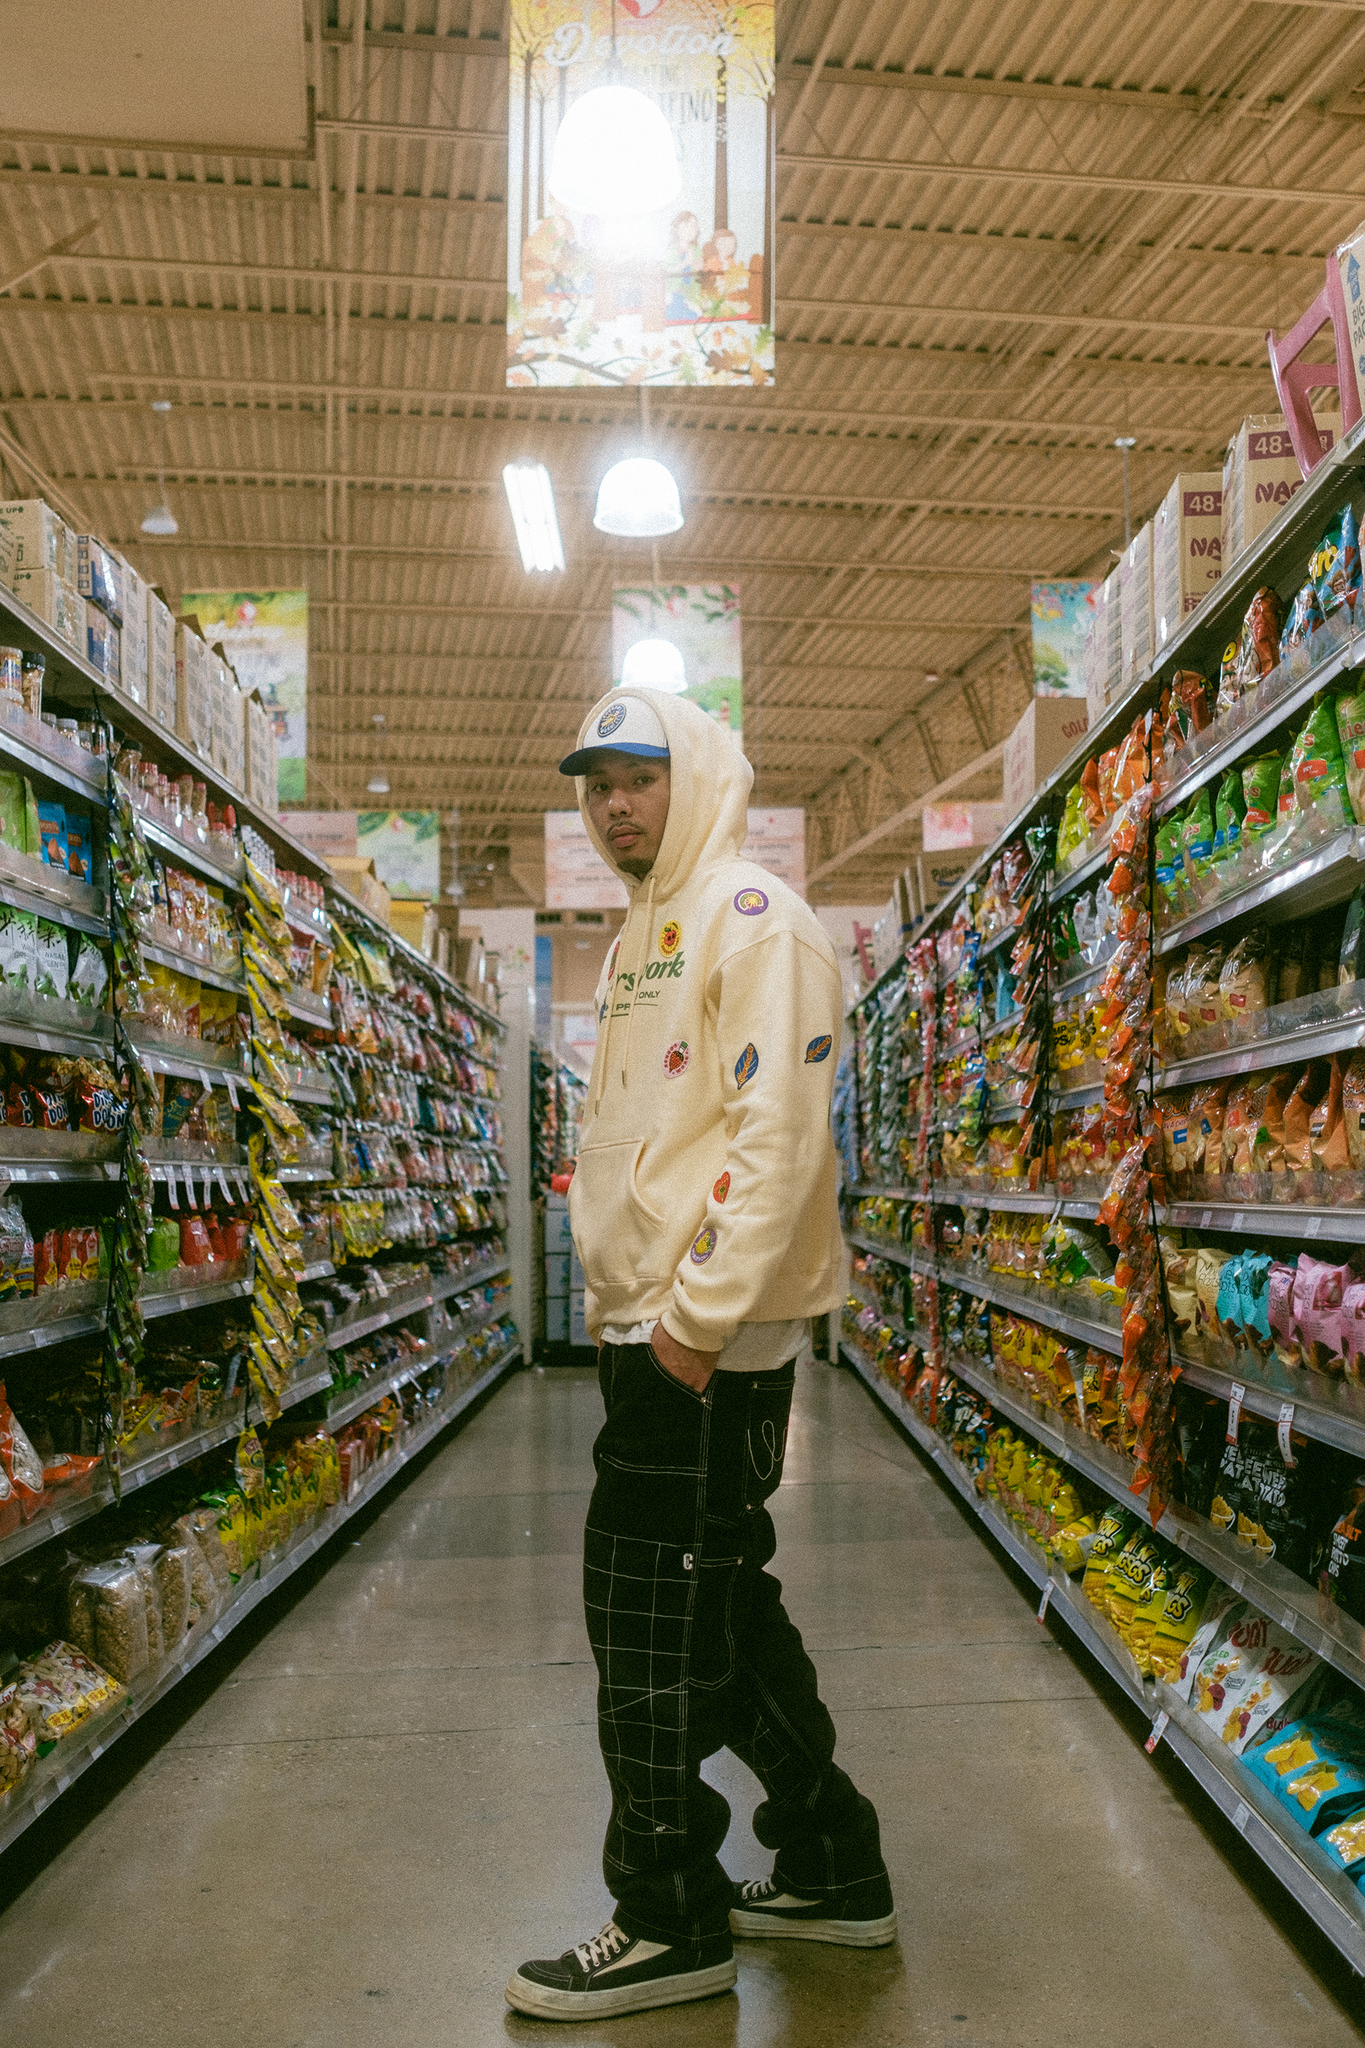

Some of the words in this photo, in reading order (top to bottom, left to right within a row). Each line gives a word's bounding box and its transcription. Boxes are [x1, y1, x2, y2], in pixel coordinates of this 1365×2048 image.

[545, 22, 738, 66] Devotion
[638, 990, 661, 999] ONLY
[682, 1552, 693, 1570] C
